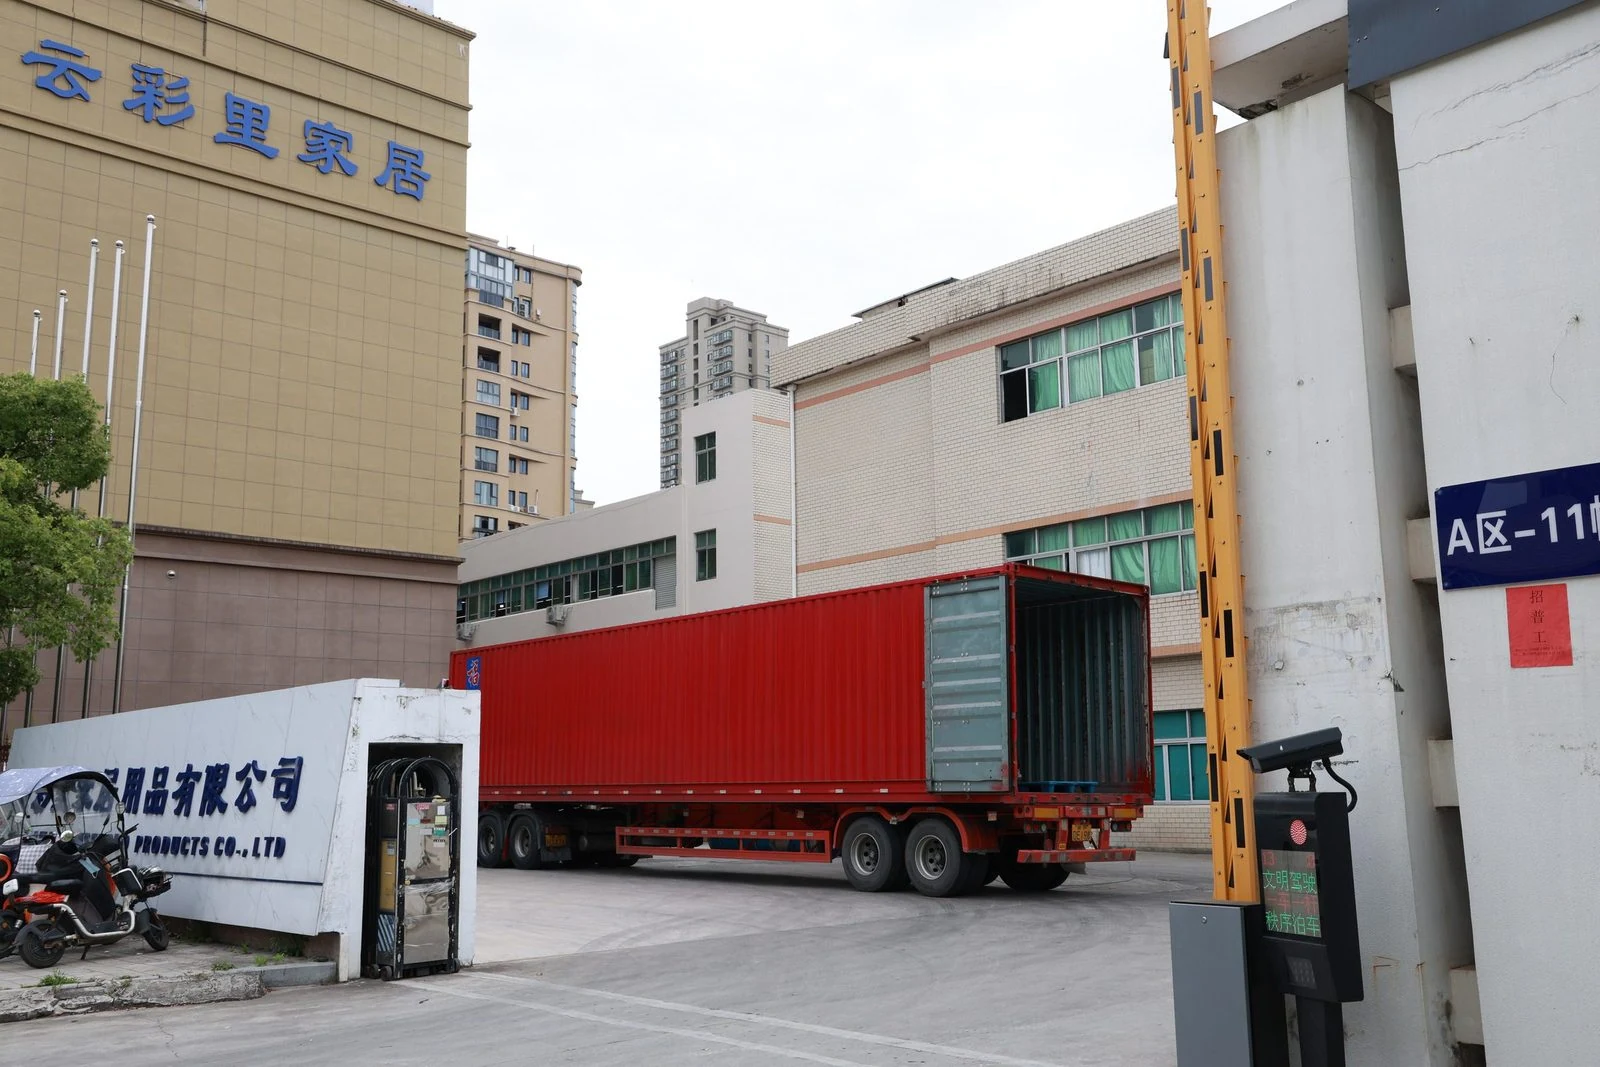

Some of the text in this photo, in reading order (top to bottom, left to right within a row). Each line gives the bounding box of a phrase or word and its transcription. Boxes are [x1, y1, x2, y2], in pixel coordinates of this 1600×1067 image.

[22, 39, 431, 200] 云彩里家居
[1447, 494, 1600, 557] A区-11
[134, 835, 210, 858] PRODUCTS
[1262, 870, 1317, 894] 文明驾驶
[1265, 910, 1321, 937] 秩序泊车
